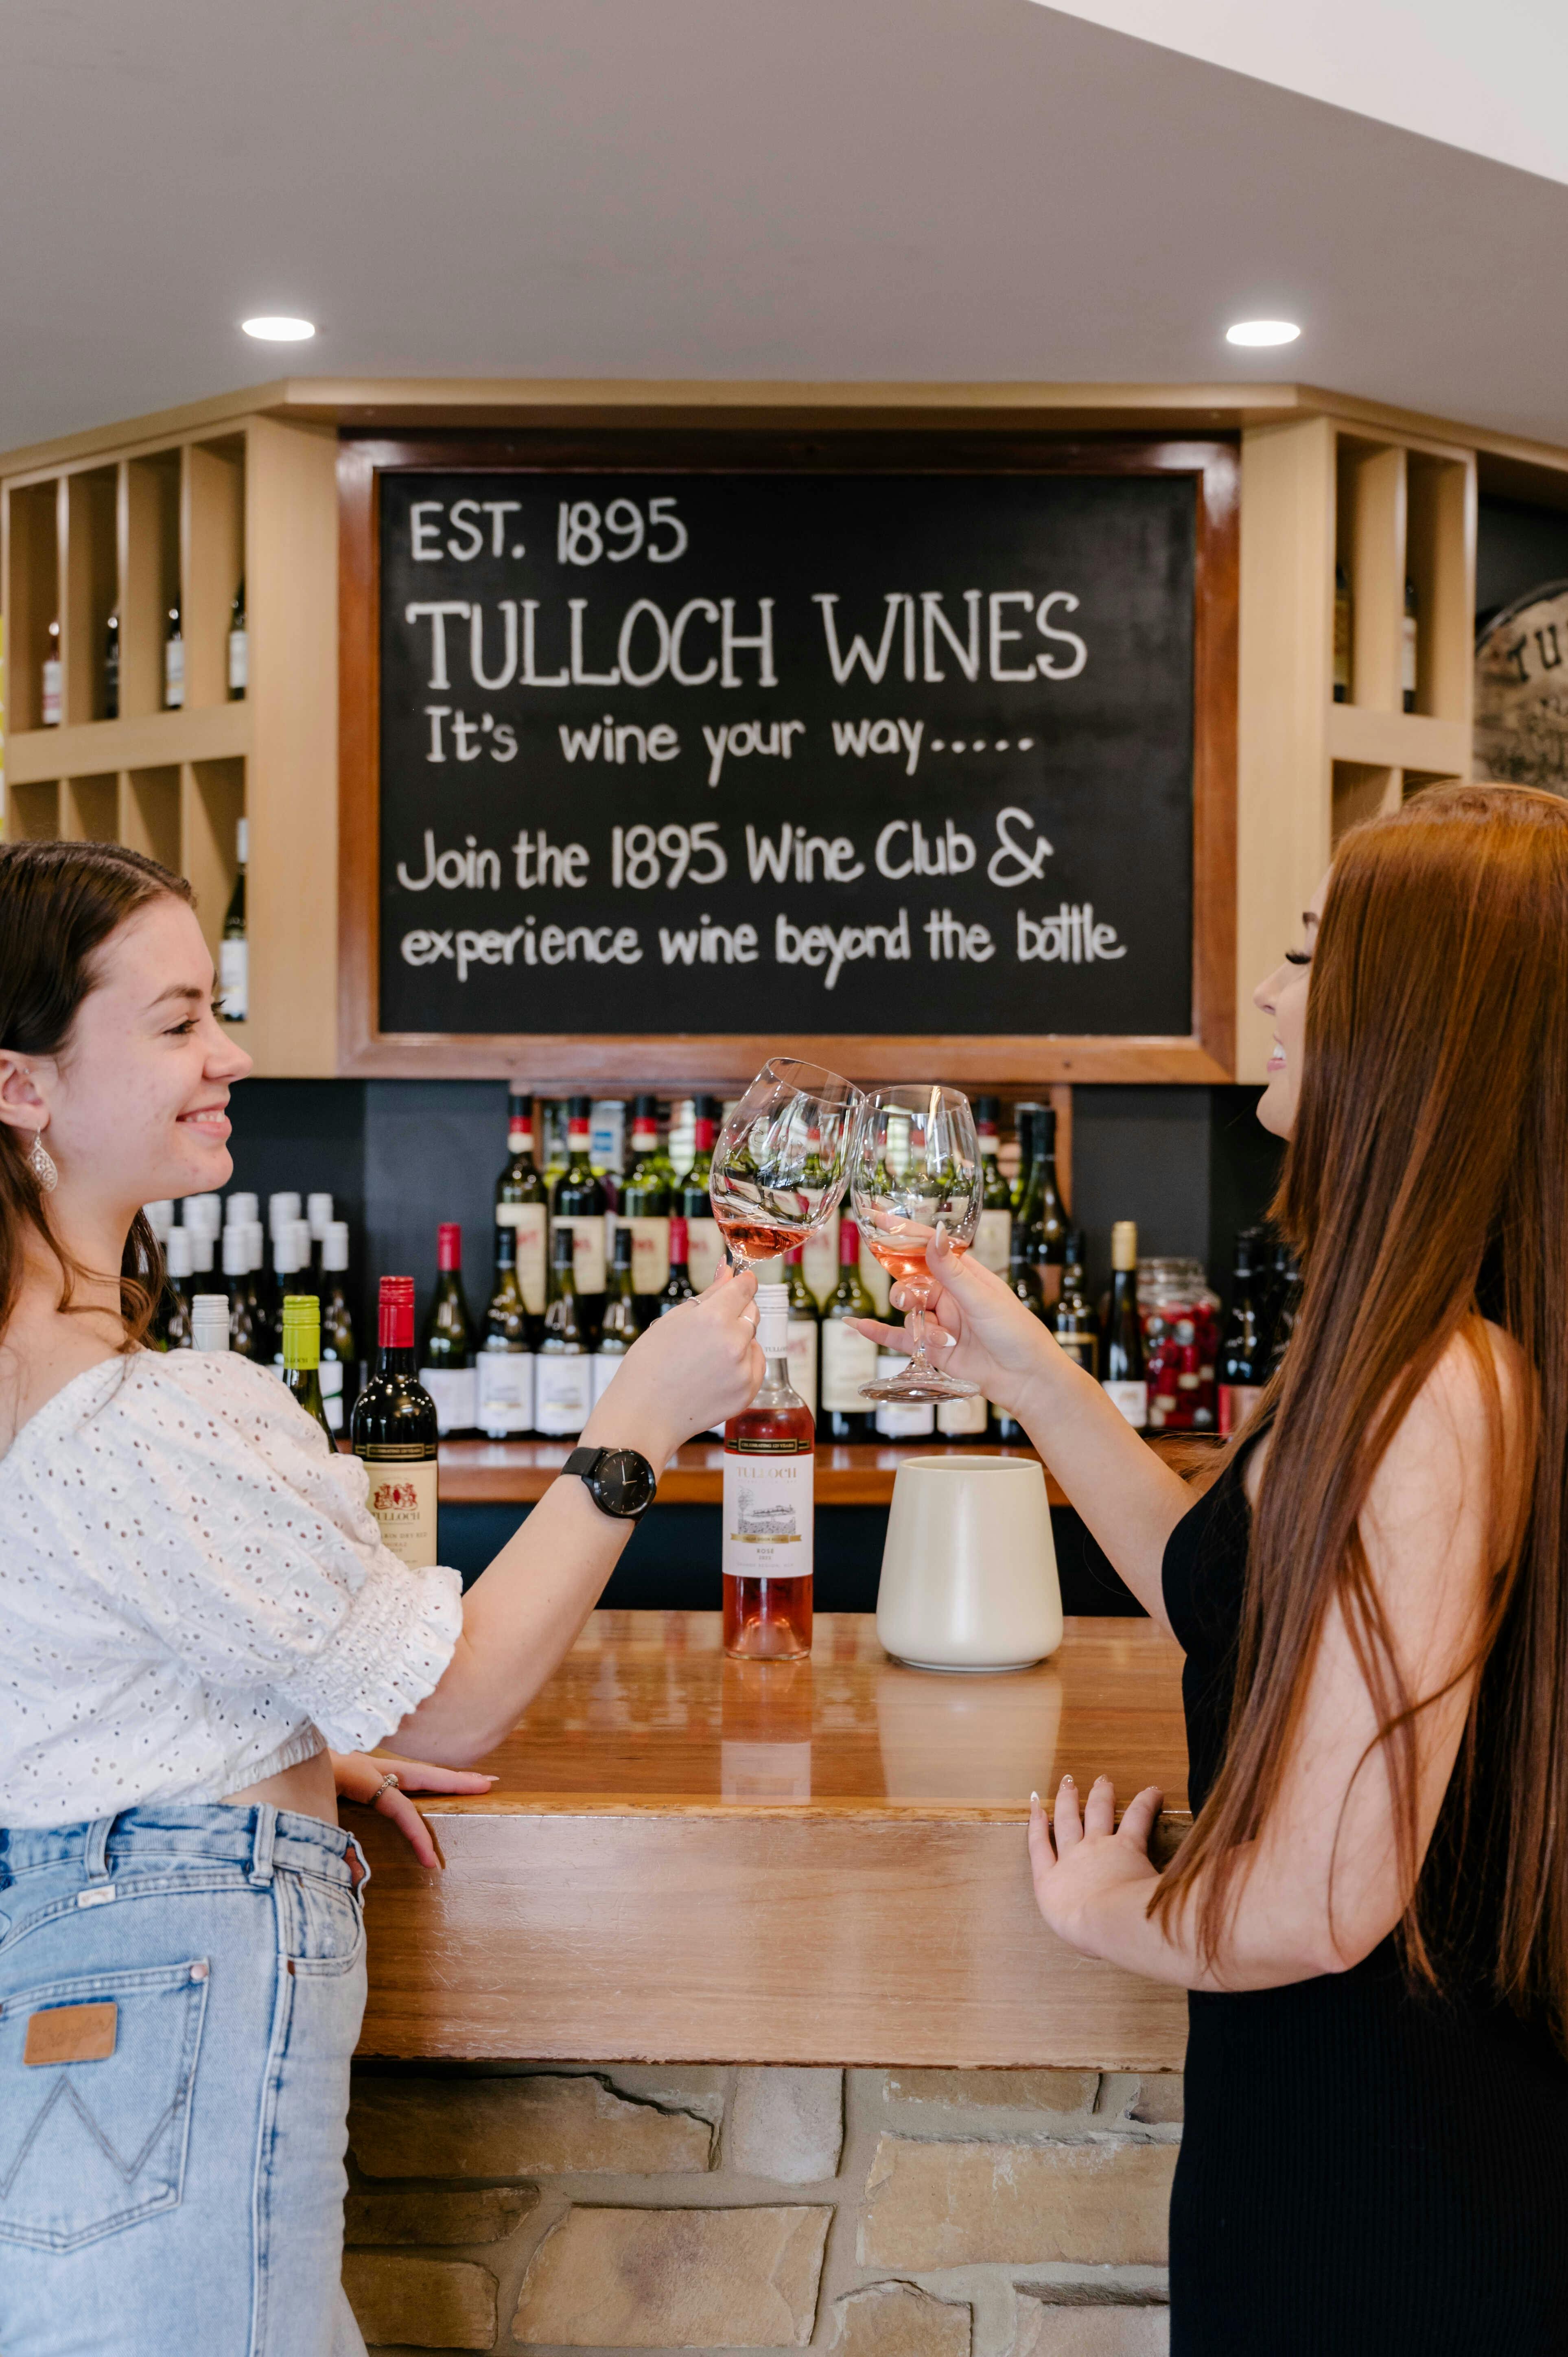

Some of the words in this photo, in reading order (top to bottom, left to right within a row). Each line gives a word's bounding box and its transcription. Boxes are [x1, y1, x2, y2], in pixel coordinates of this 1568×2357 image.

[410, 499, 526, 562] EST.
[557, 497, 688, 566] 1895
[404, 597, 779, 691] TULLOCH
[812, 589, 1089, 684] WINES
[424, 705, 518, 763] It's
[558, 714, 680, 764] wine
[702, 720, 805, 788] your
[397, 829, 501, 891] Join
[512, 830, 590, 890] the
[612, 821, 728, 890] 1895
[745, 823, 866, 884] Wine
[875, 818, 977, 880] Club
[986, 806, 1054, 888] &
[400, 915, 643, 983] experience
[658, 913, 759, 965] wine
[775, 908, 911, 990] beyond
[923, 908, 996, 963] the
[1016, 902, 1127, 964] bottle
